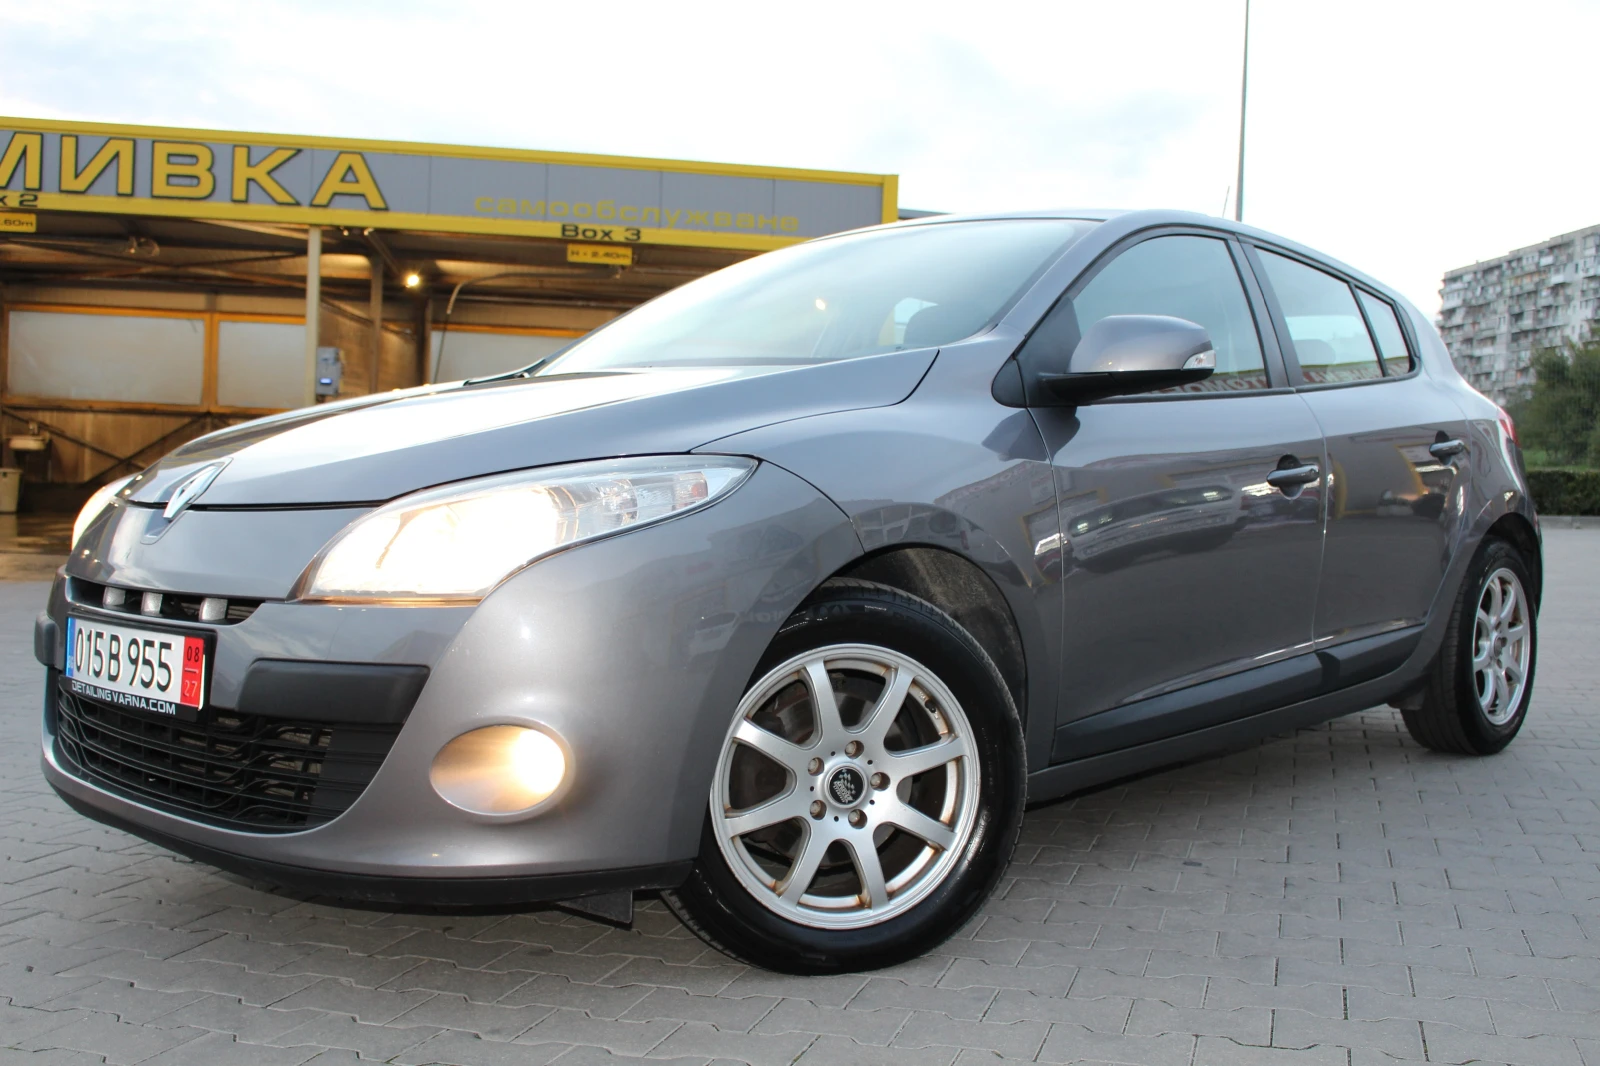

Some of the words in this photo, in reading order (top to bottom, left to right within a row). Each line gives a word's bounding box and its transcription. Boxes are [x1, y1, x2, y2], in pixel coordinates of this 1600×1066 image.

[474, 196, 799, 232] самообслужване
[561, 223, 613, 240] Box
[624, 227, 641, 241] 3
[186, 645, 200, 662] 08
[182, 679, 198, 698] 27
